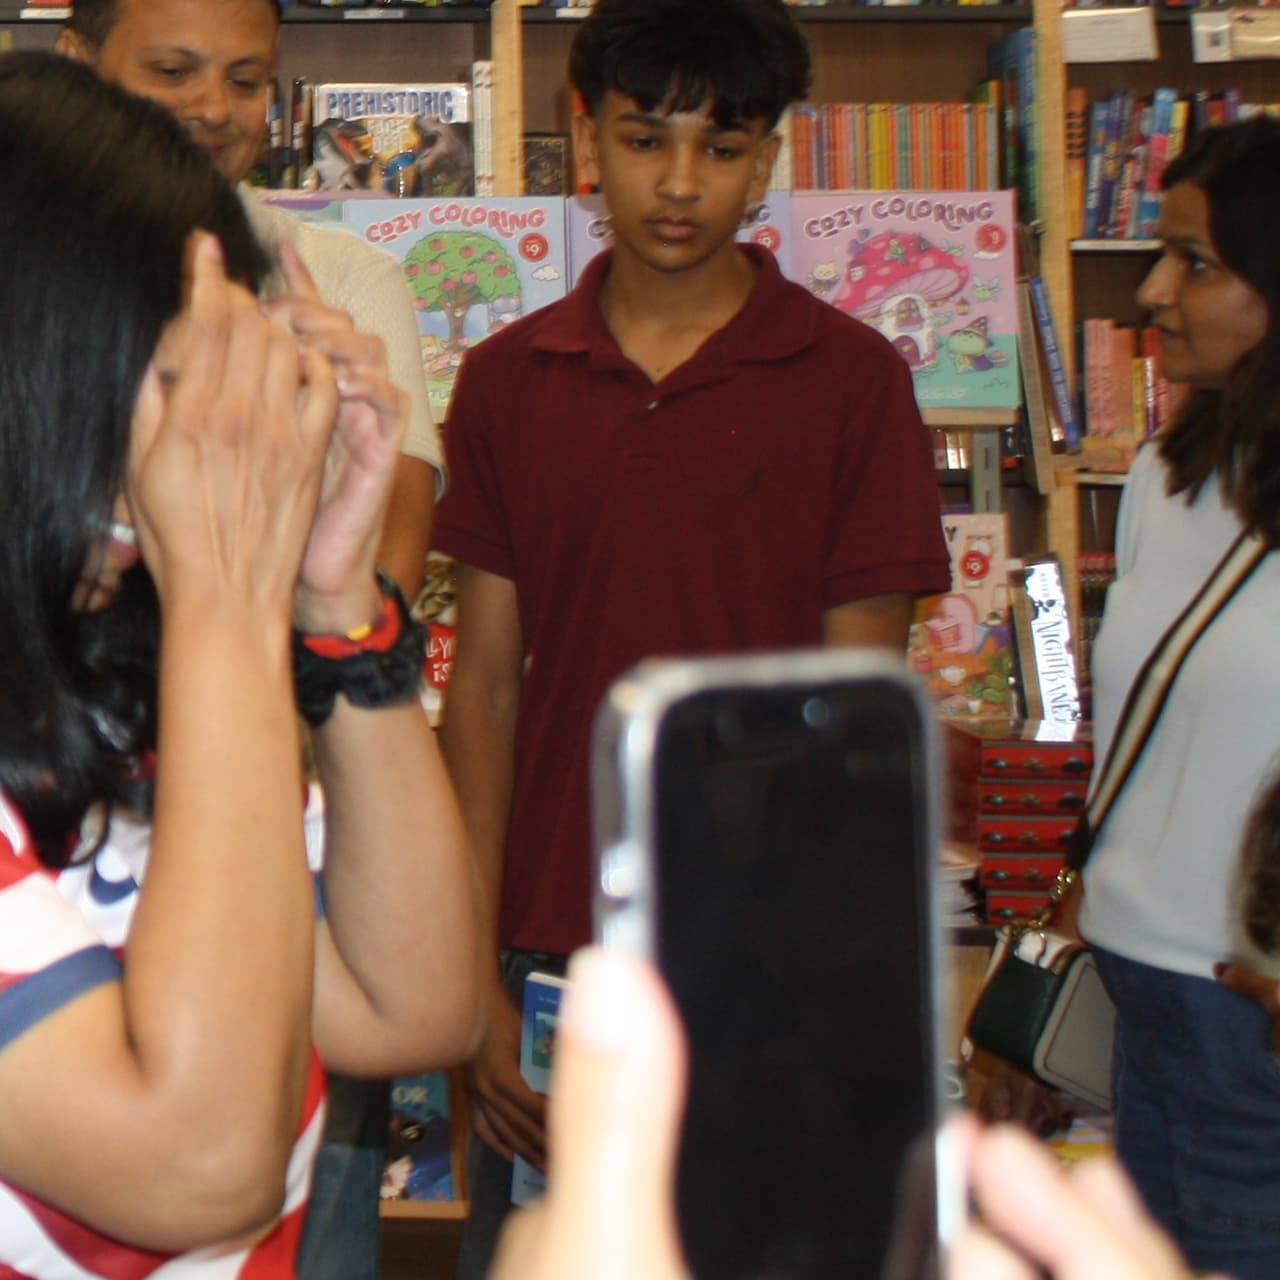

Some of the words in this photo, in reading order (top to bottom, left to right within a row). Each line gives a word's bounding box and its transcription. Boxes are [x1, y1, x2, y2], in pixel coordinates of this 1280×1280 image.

[328, 91, 454, 122] PREHISTORIC
[366, 210, 422, 243] COZY
[429, 202, 546, 238] COLORING
[804, 205, 864, 238] COZY
[872, 197, 995, 231] COLORING
